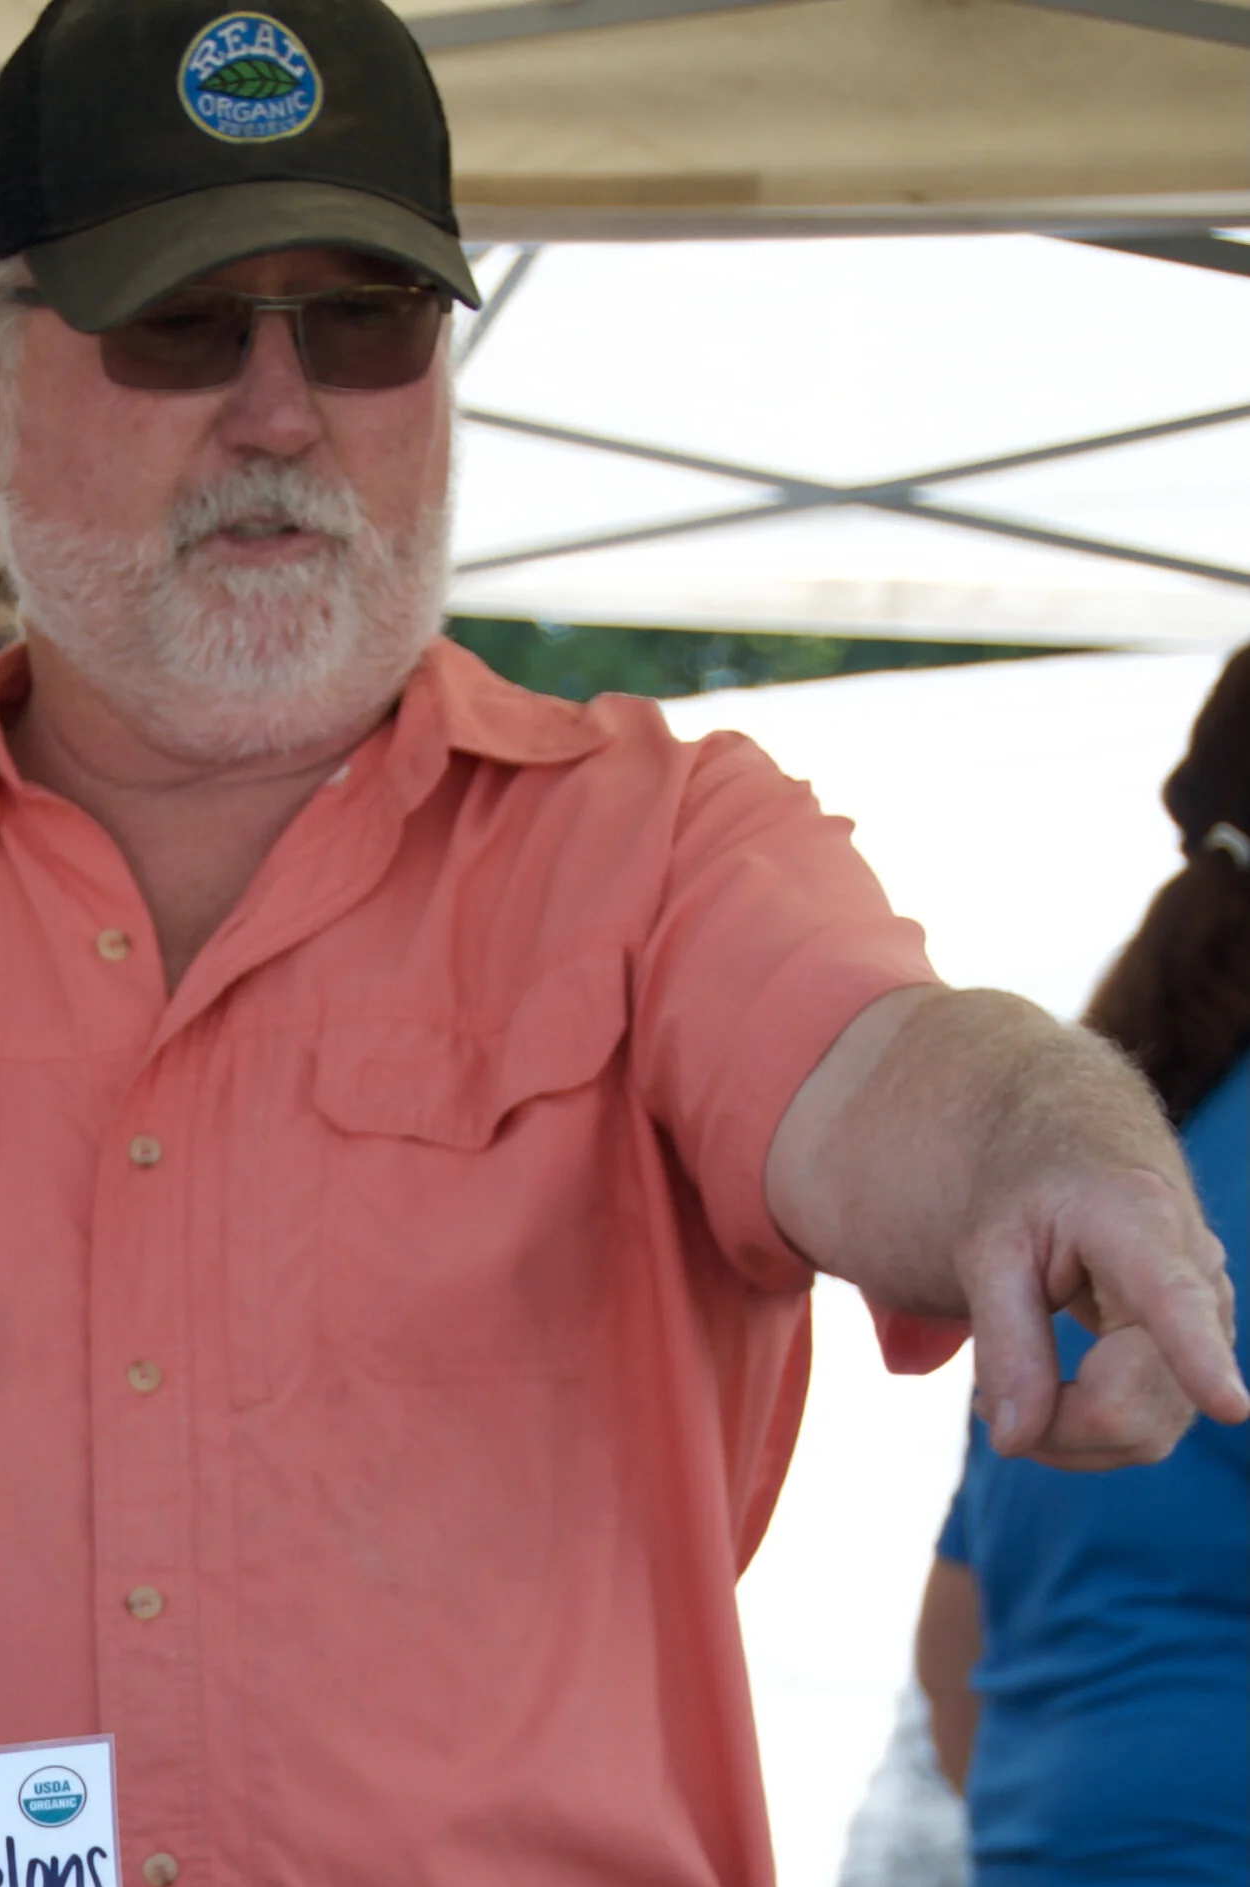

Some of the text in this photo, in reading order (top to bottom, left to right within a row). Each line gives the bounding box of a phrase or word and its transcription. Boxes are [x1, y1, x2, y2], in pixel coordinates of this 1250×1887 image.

[188, 21, 306, 80] REAL
[198, 90, 310, 122] ORGANIC
[34, 1780, 71, 1795] USDA
[29, 1797, 78, 1812] ORGANIC
